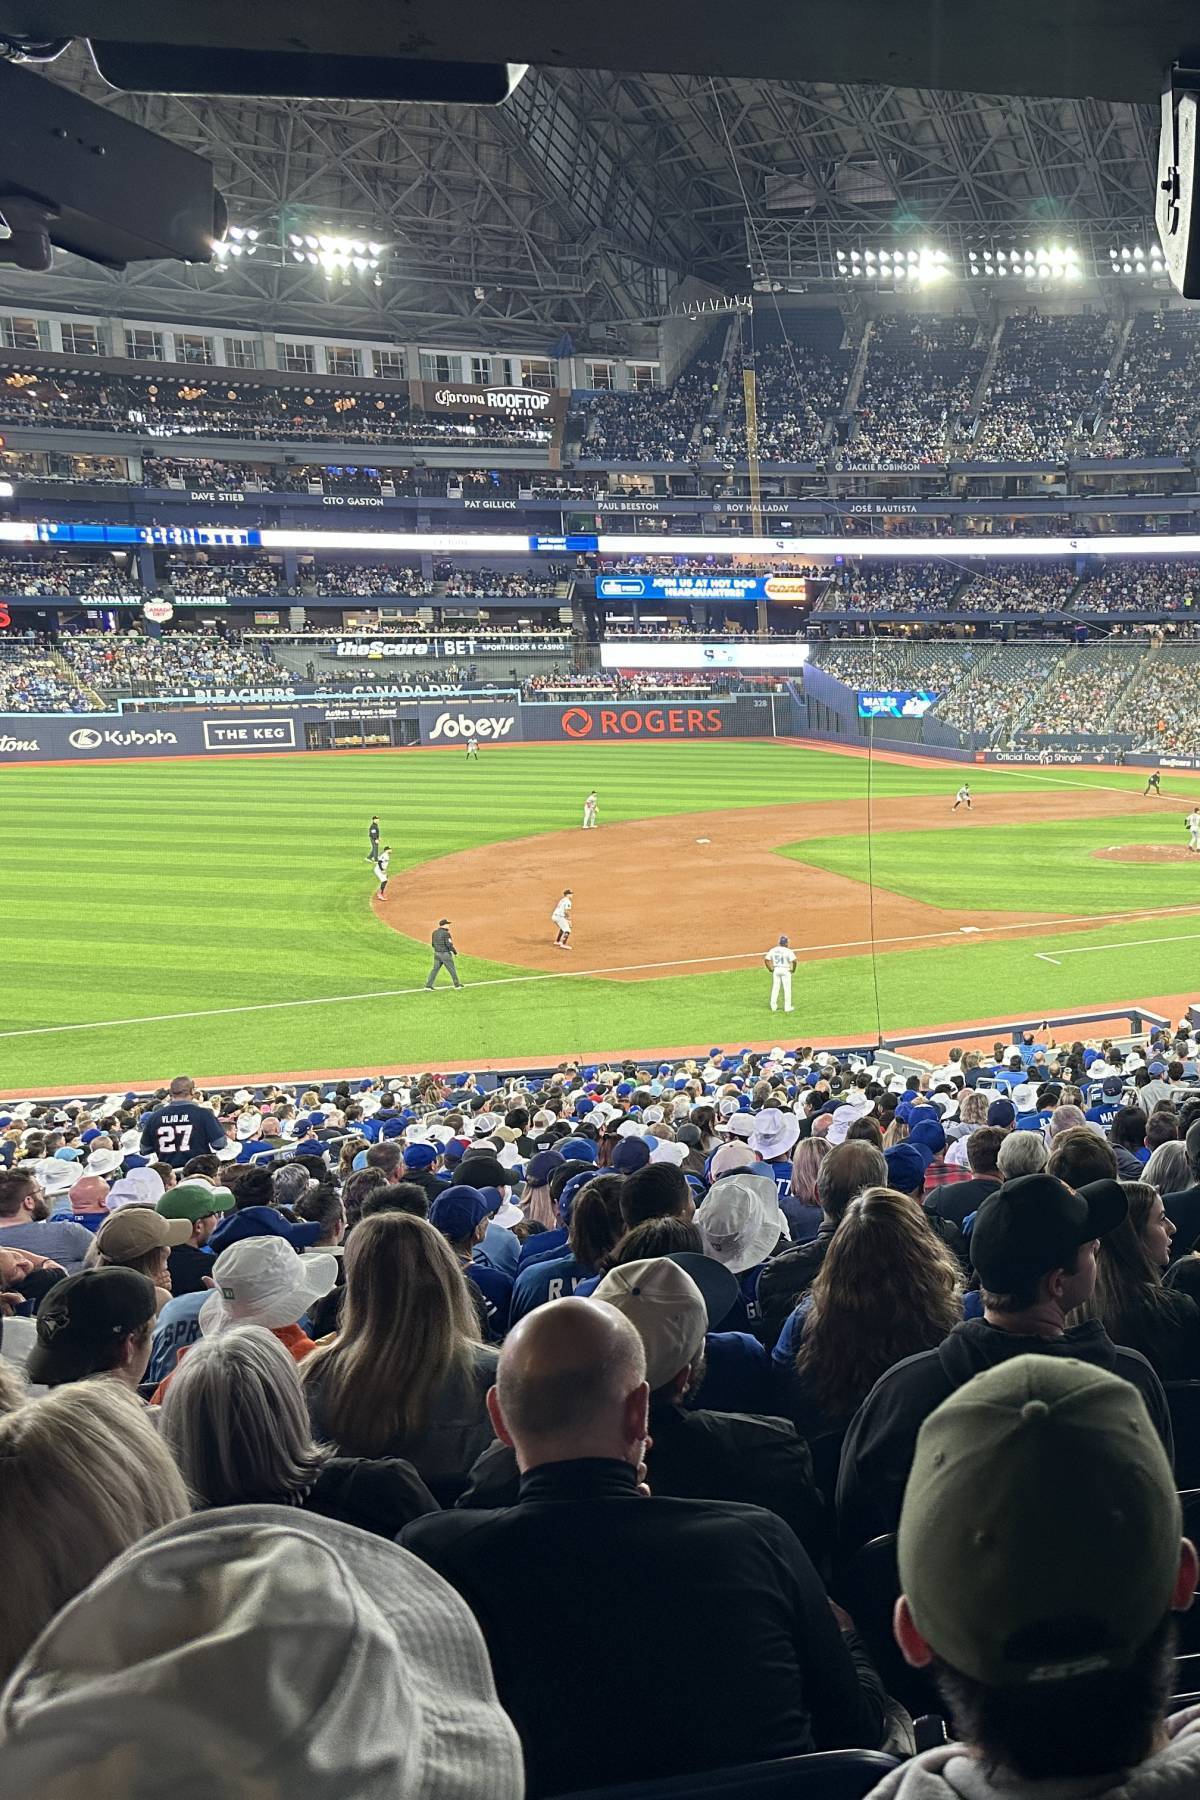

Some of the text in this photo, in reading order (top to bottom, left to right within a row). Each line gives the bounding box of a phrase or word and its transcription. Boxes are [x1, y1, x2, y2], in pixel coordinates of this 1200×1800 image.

[435, 389, 550, 409] Corona ROOFTOP
[506, 408, 533, 416] PATIO
[191, 492, 244, 501] DAVE STIEB
[323, 496, 384, 506] CITO GASTON
[464, 500, 516, 509] PAT GILLICK
[597, 502, 659, 510] PAUL BEESTON
[726, 503, 789, 512] ROY HALLADAY
[850, 503, 917, 513] JOSÉ BAUTISTA
[652, 578, 677, 588] JOIN
[679, 579, 693, 588] US
[696, 579, 709, 588] AT
[80, 595, 141, 605] CANADA DRY
[175, 595, 227, 605] BLEACHERS
[337, 641, 428, 656] theScore
[444, 641, 476, 655] BET
[194, 687, 296, 703] BLEACHERS
[352, 685, 423, 697] CANADA
[429, 712, 515, 739] Sobeys
[601, 709, 722, 734] ROGERS
[105, 730, 178, 745] Kubota
[215, 728, 285, 740] THE KEG
[1025, 753, 1053, 763] Roog
[1054, 754, 1082, 763] Shingle
[158, 1124, 193, 1152] 27
